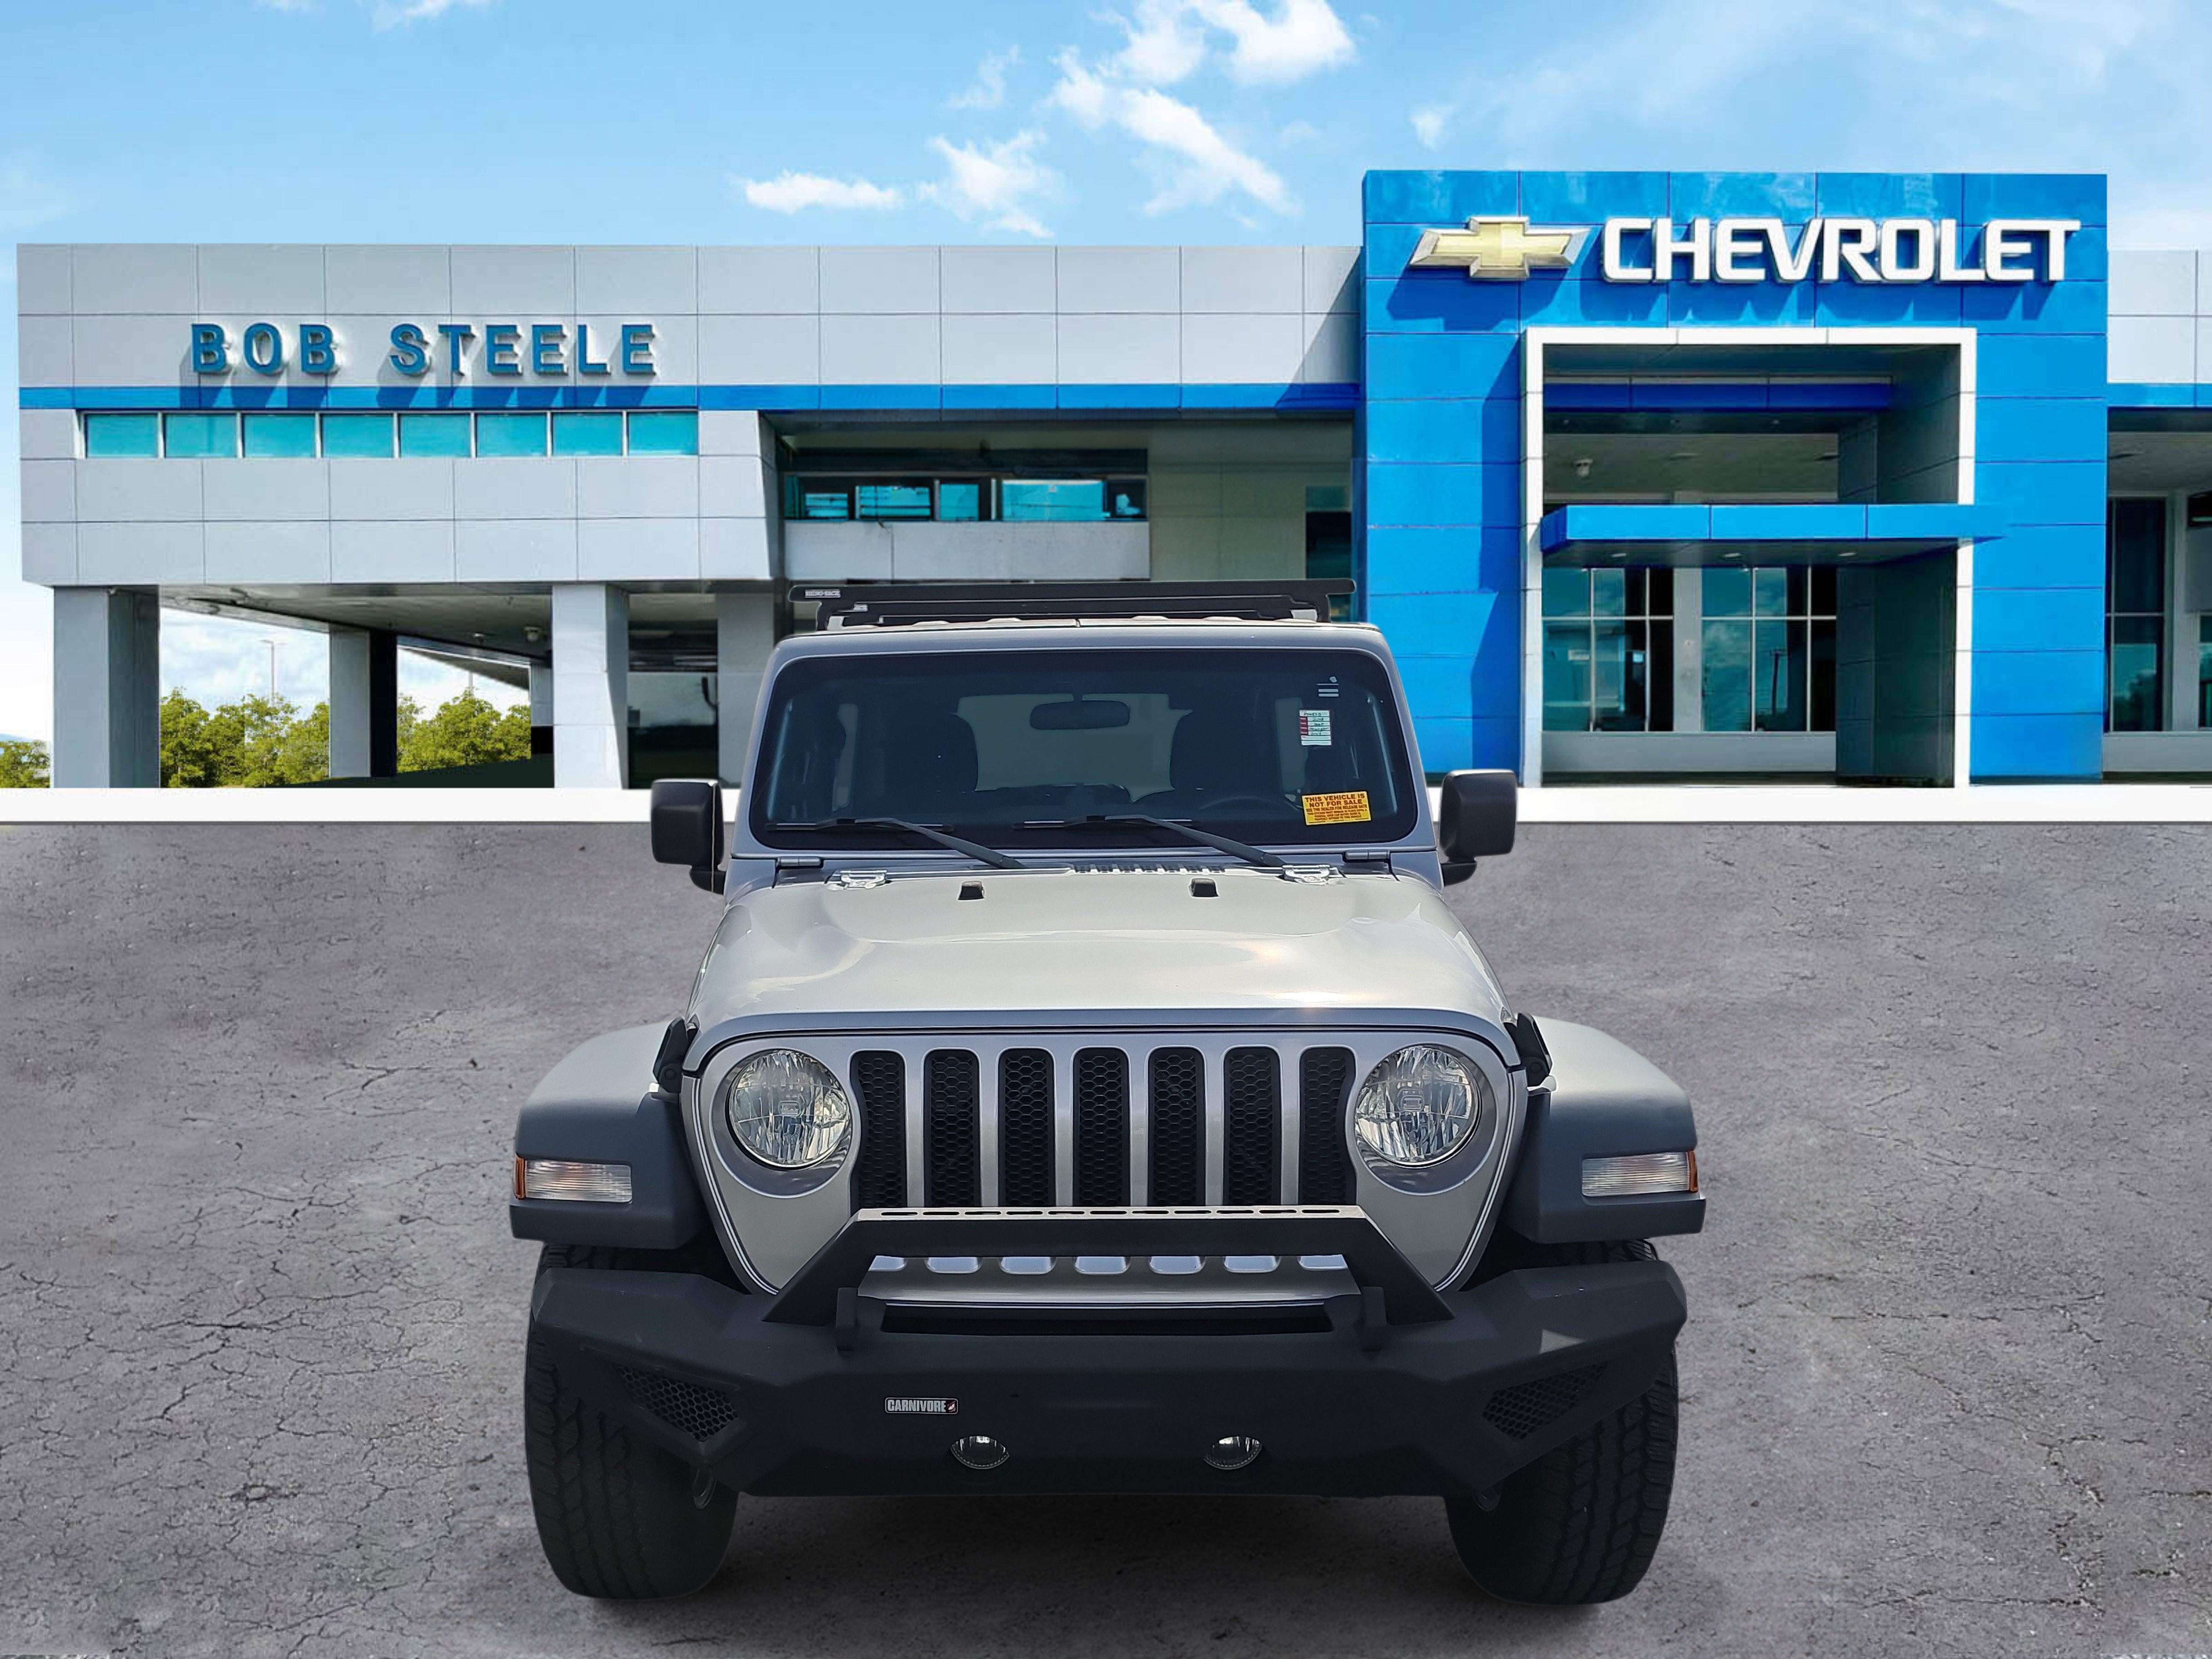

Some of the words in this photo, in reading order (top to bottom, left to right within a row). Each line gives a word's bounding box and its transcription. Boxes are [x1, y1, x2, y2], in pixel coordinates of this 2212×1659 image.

[1602, 217, 2081, 283] CHEVROLET
[190, 323, 338, 376] BOB
[389, 323, 656, 376] STEELE
[888, 1400, 946, 1412] CARNIVORE
